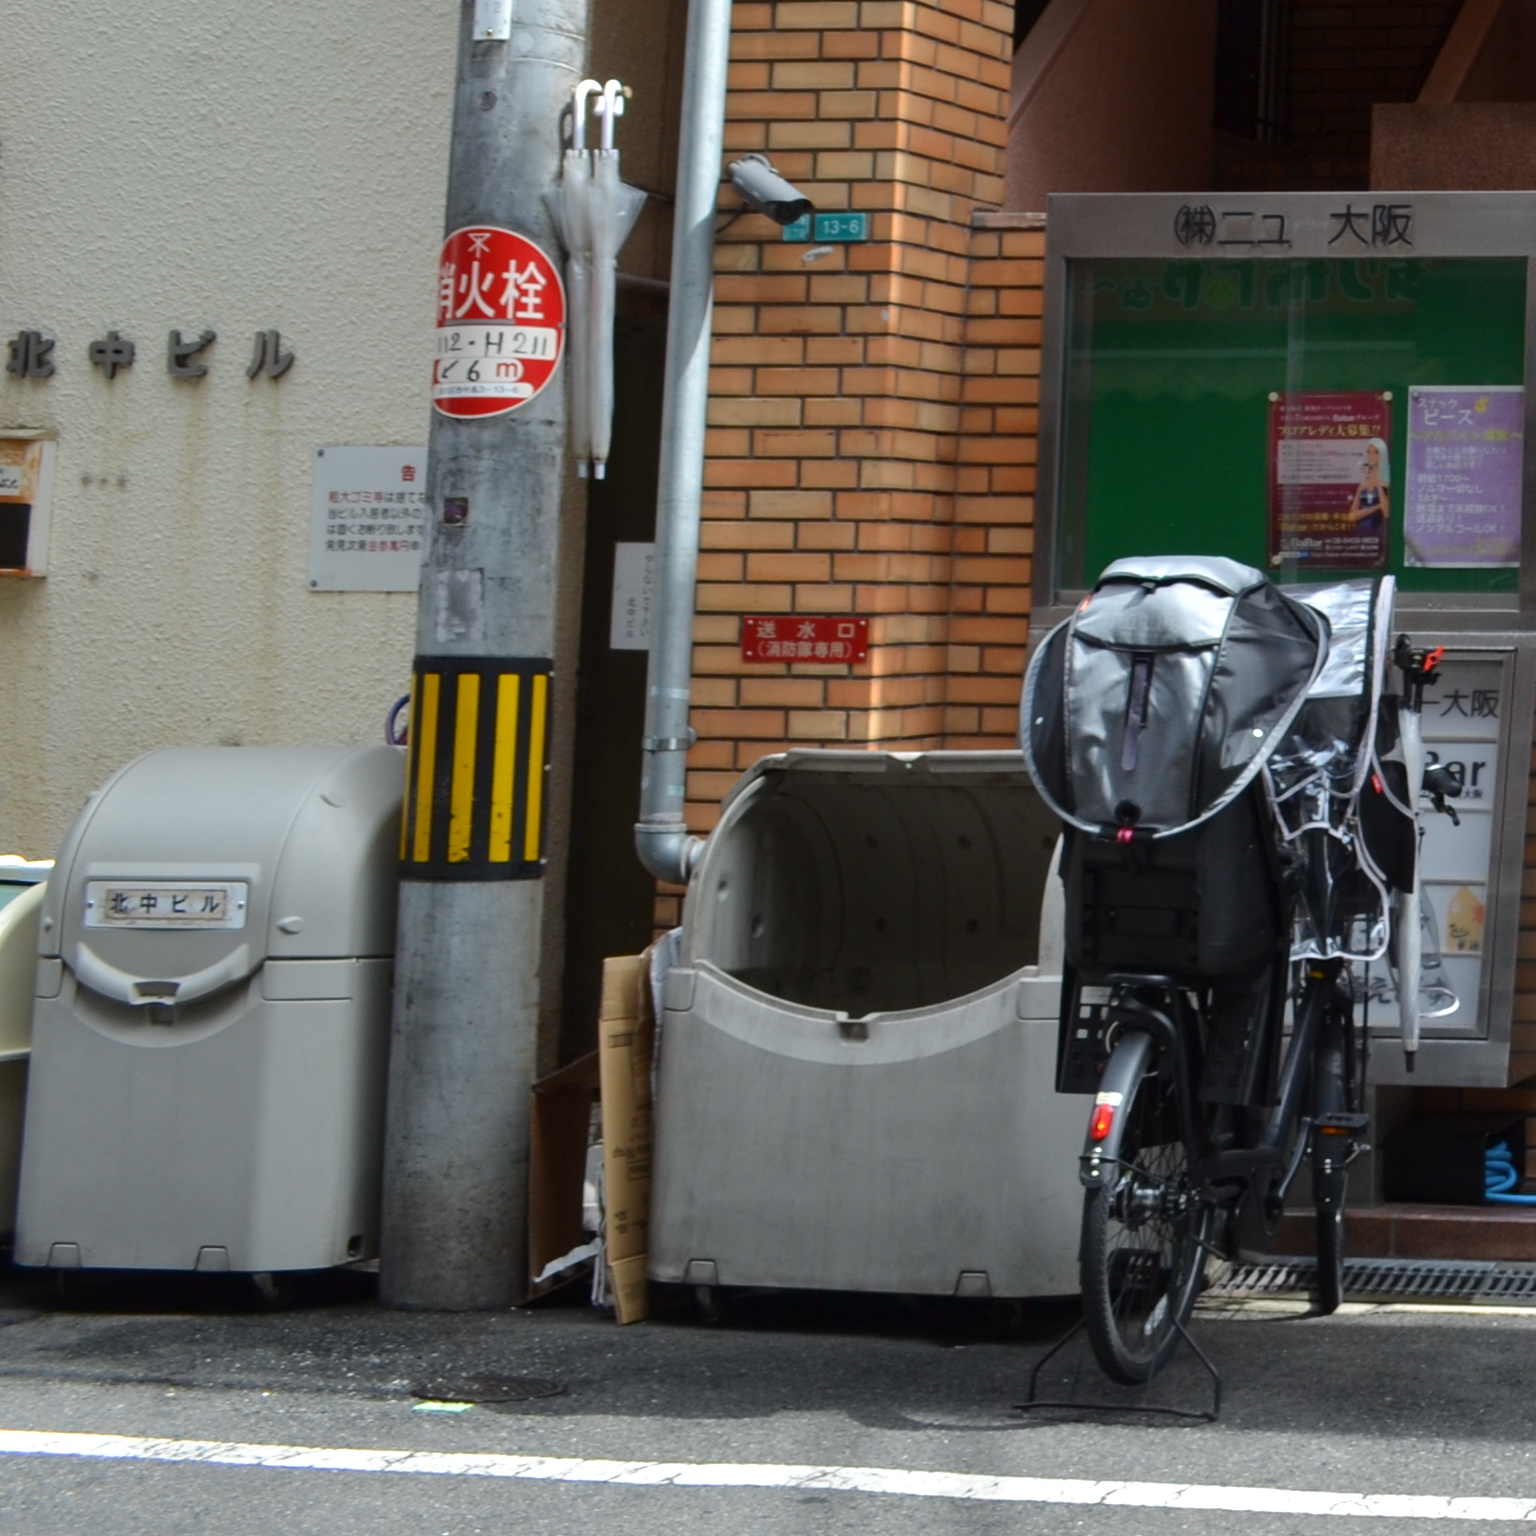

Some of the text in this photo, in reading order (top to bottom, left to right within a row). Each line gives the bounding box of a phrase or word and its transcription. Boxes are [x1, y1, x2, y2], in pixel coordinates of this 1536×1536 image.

[822, 219, 860, 235] 13-6
[5, 329, 296, 381] 北中ビル
[757, 620, 856, 640] 送水口
[109, 889, 223, 917] 北中ビル
